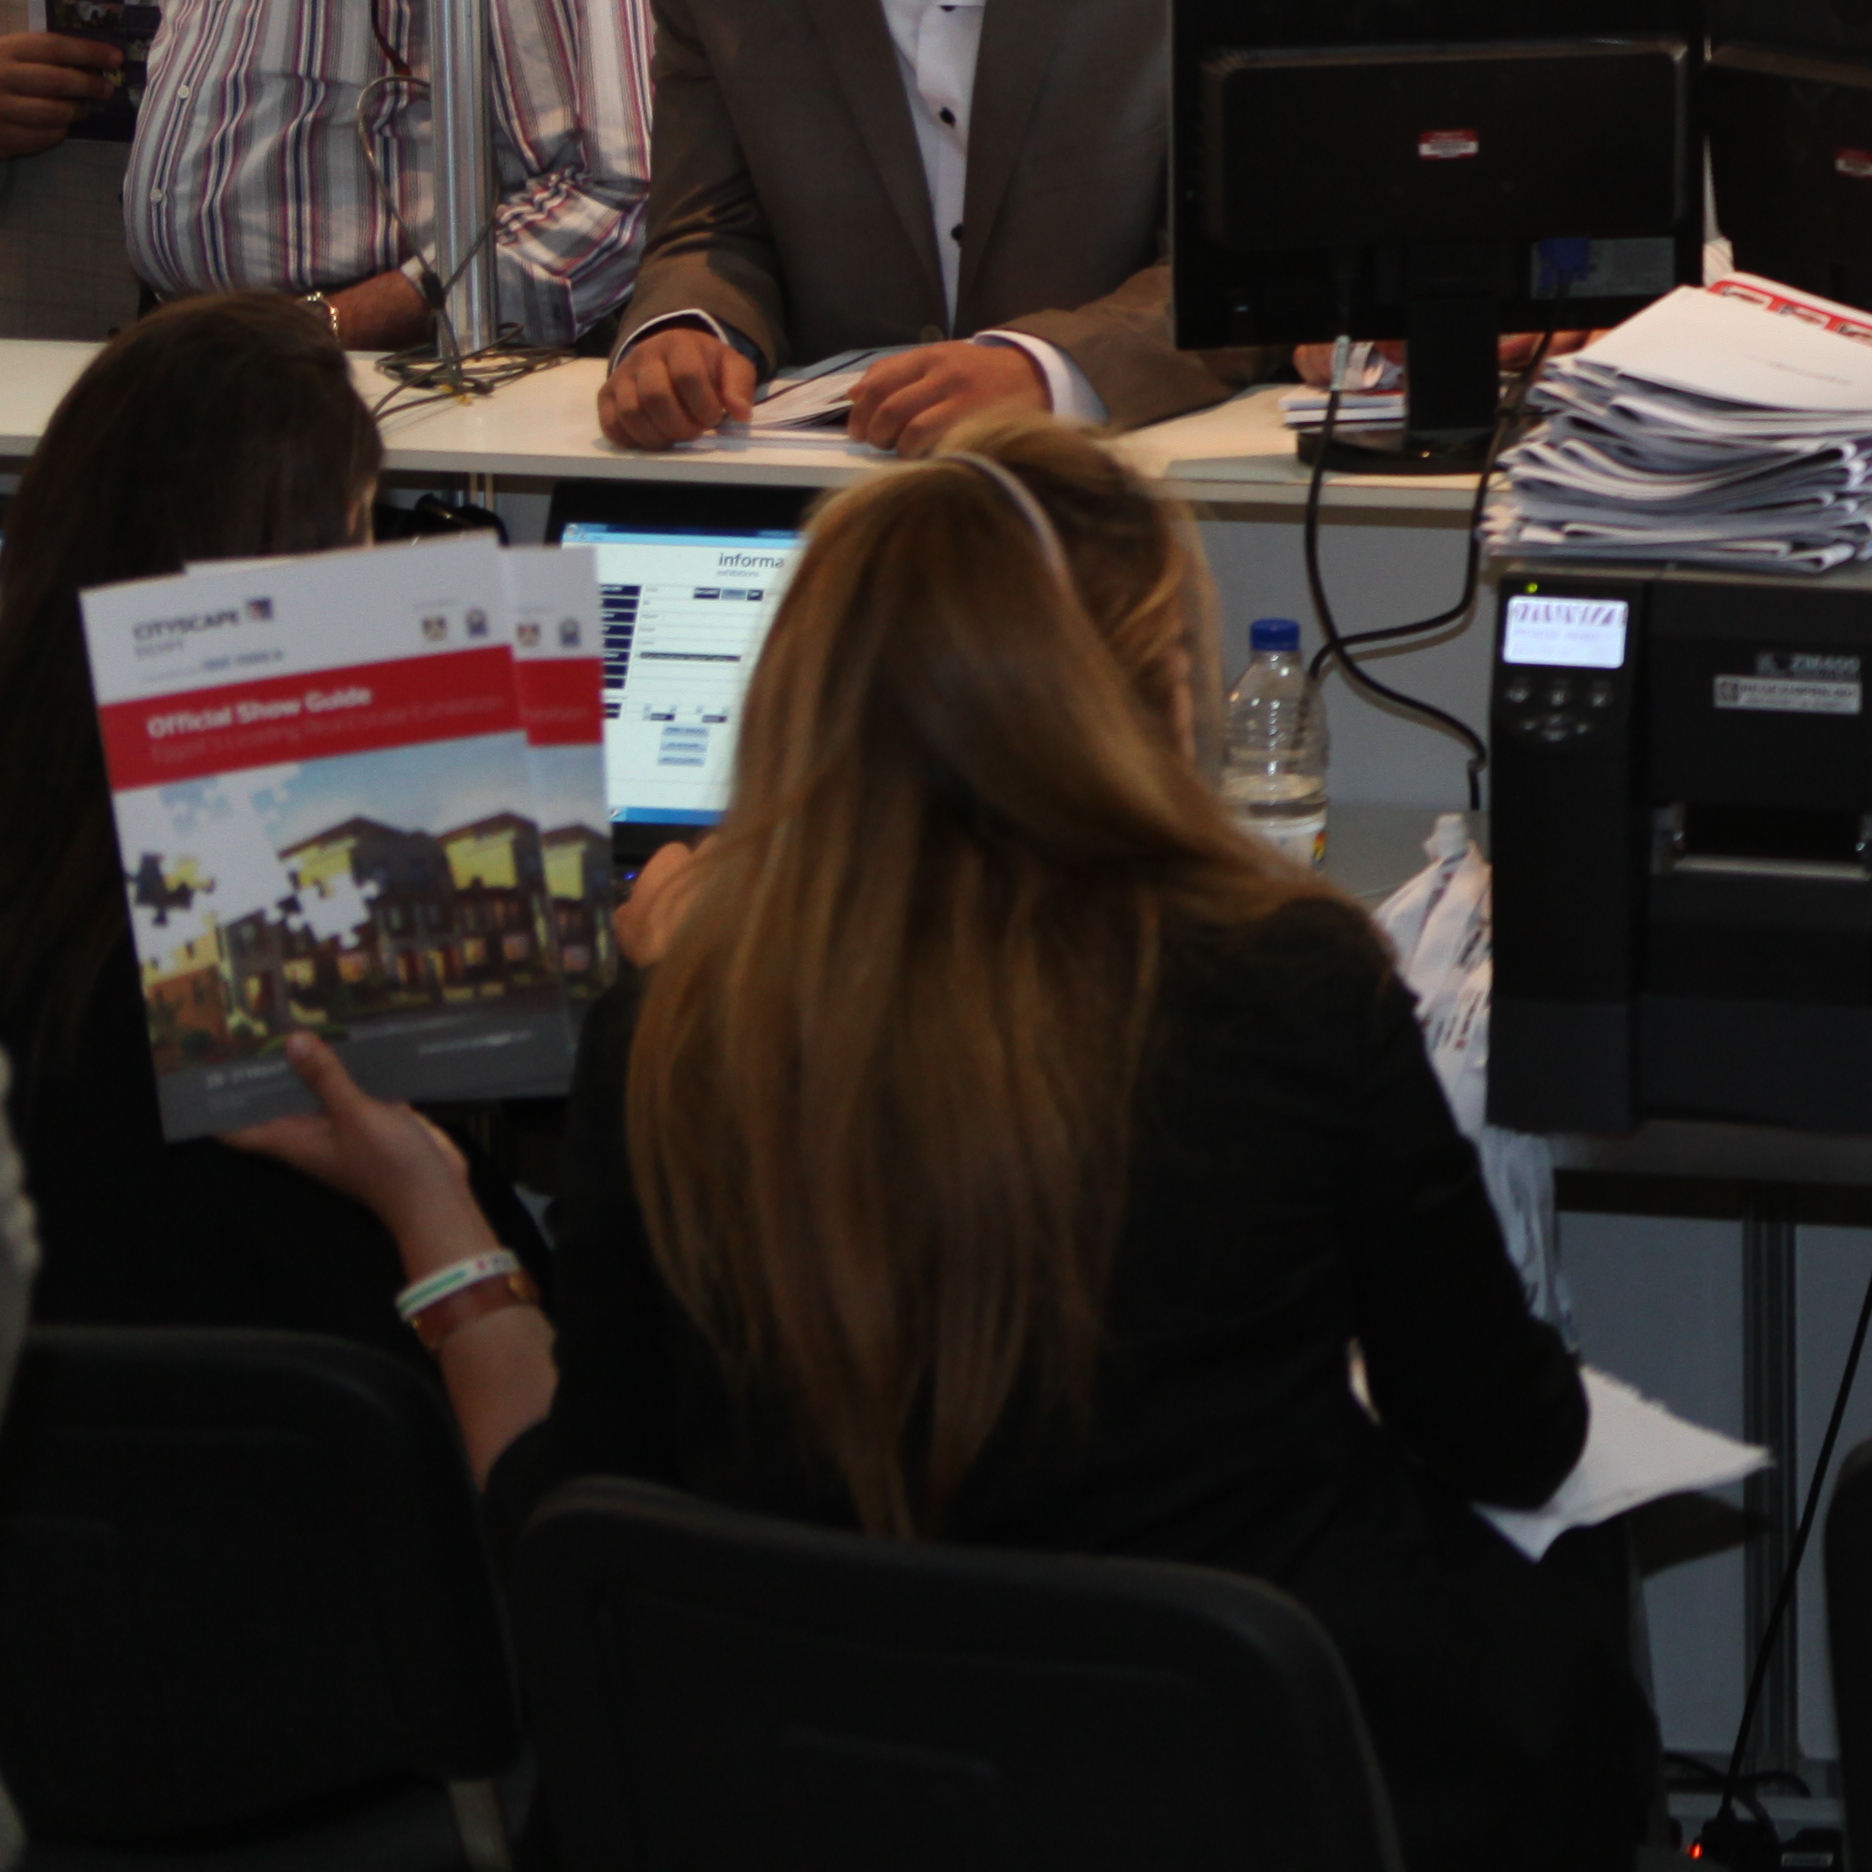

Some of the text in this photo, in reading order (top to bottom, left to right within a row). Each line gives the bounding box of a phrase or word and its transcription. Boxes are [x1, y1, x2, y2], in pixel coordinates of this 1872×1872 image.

[718, 552, 785, 569] informa
[132, 609, 240, 641] CITYSCAPE
[147, 685, 373, 740] Official Show Guide
